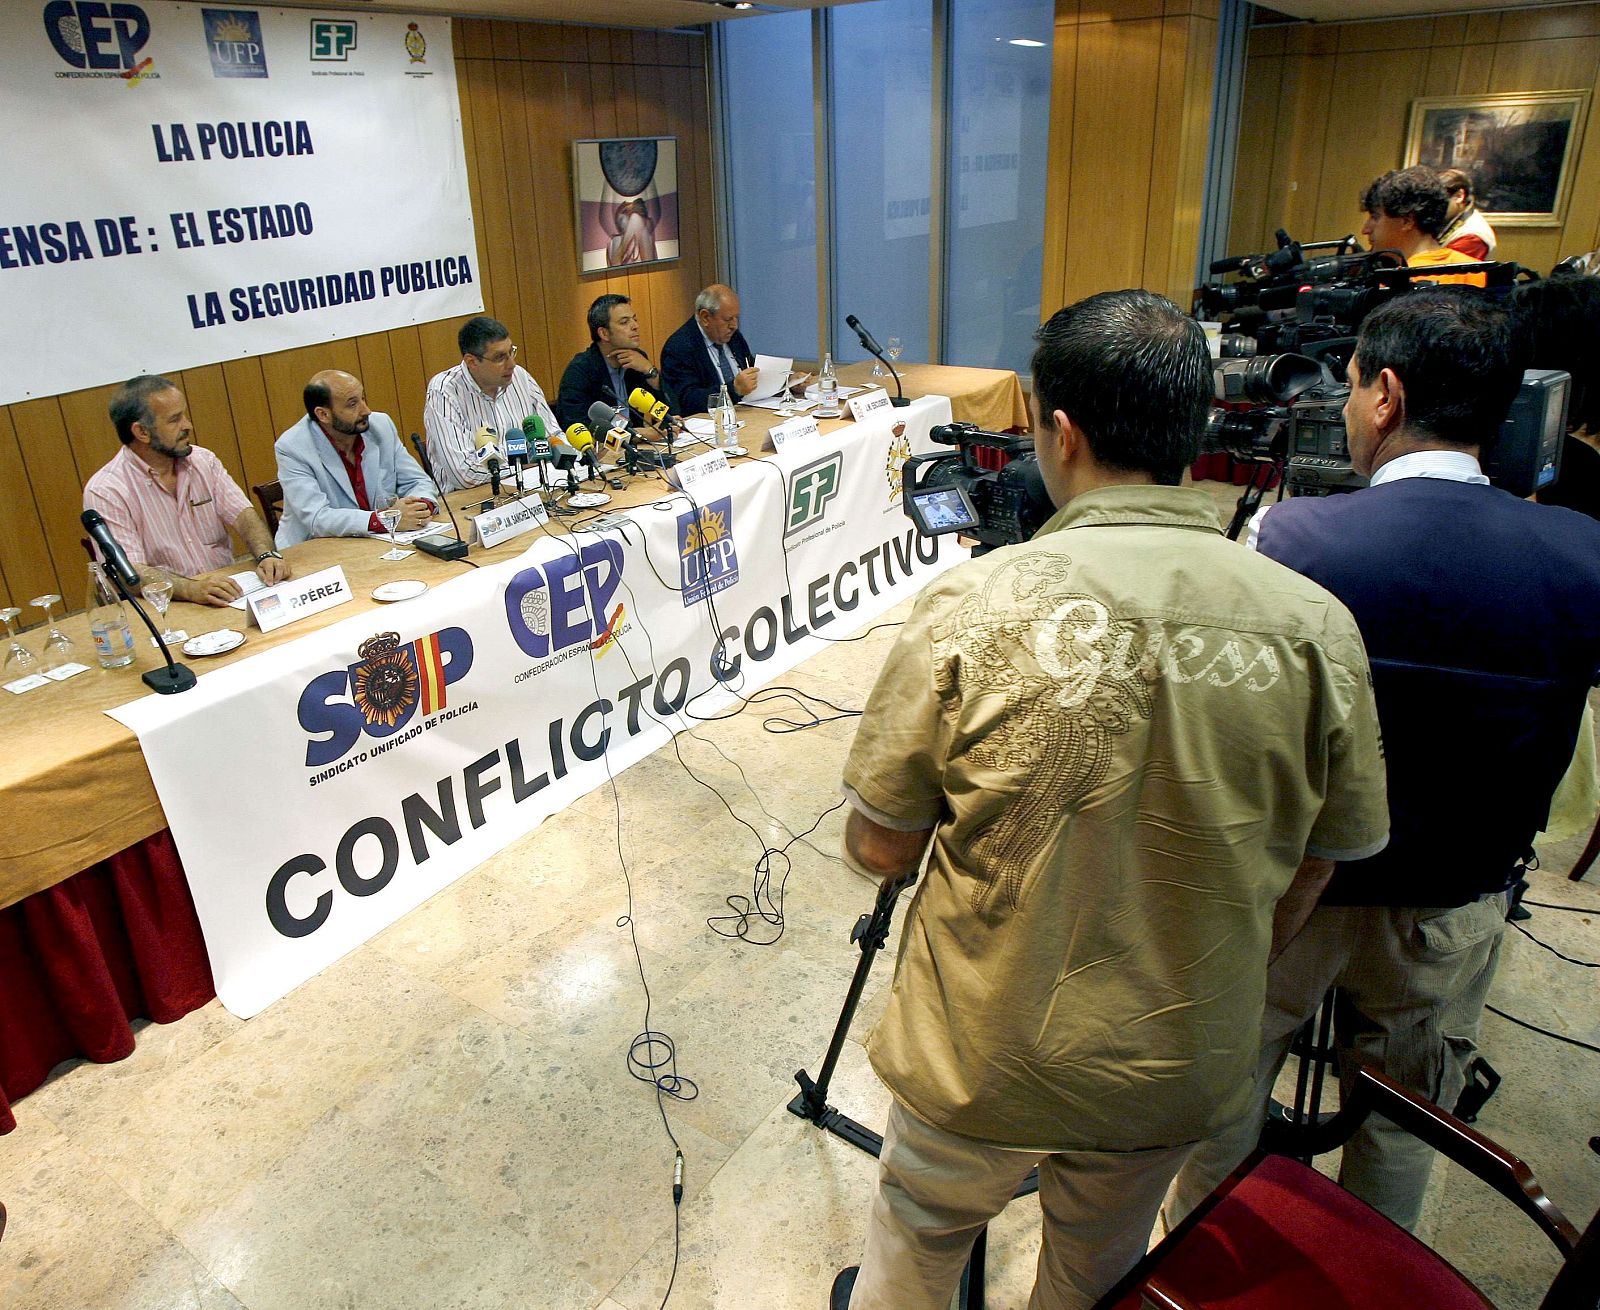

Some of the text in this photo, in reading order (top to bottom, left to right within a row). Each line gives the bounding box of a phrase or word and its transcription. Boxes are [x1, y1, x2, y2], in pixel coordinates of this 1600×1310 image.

[43, 0, 150, 69] CEP
[214, 42, 260, 65] UFP
[151, 120, 314, 162] LA POLICIA
[170, 212, 205, 249] EL
[207, 201, 314, 245] ESTADO
[187, 255, 473, 329] LA SEGURIDAD PUBLICA
[504, 538, 625, 659] CEP
[681, 537, 736, 588] UFP
[1034, 598, 1281, 708] Guess
[265, 528, 939, 938] CONFLICTO COLECTIVO
[297, 625, 474, 767] SUP
[309, 700, 479, 787] SINDICATO UNIFICADO DE POLICÍA
